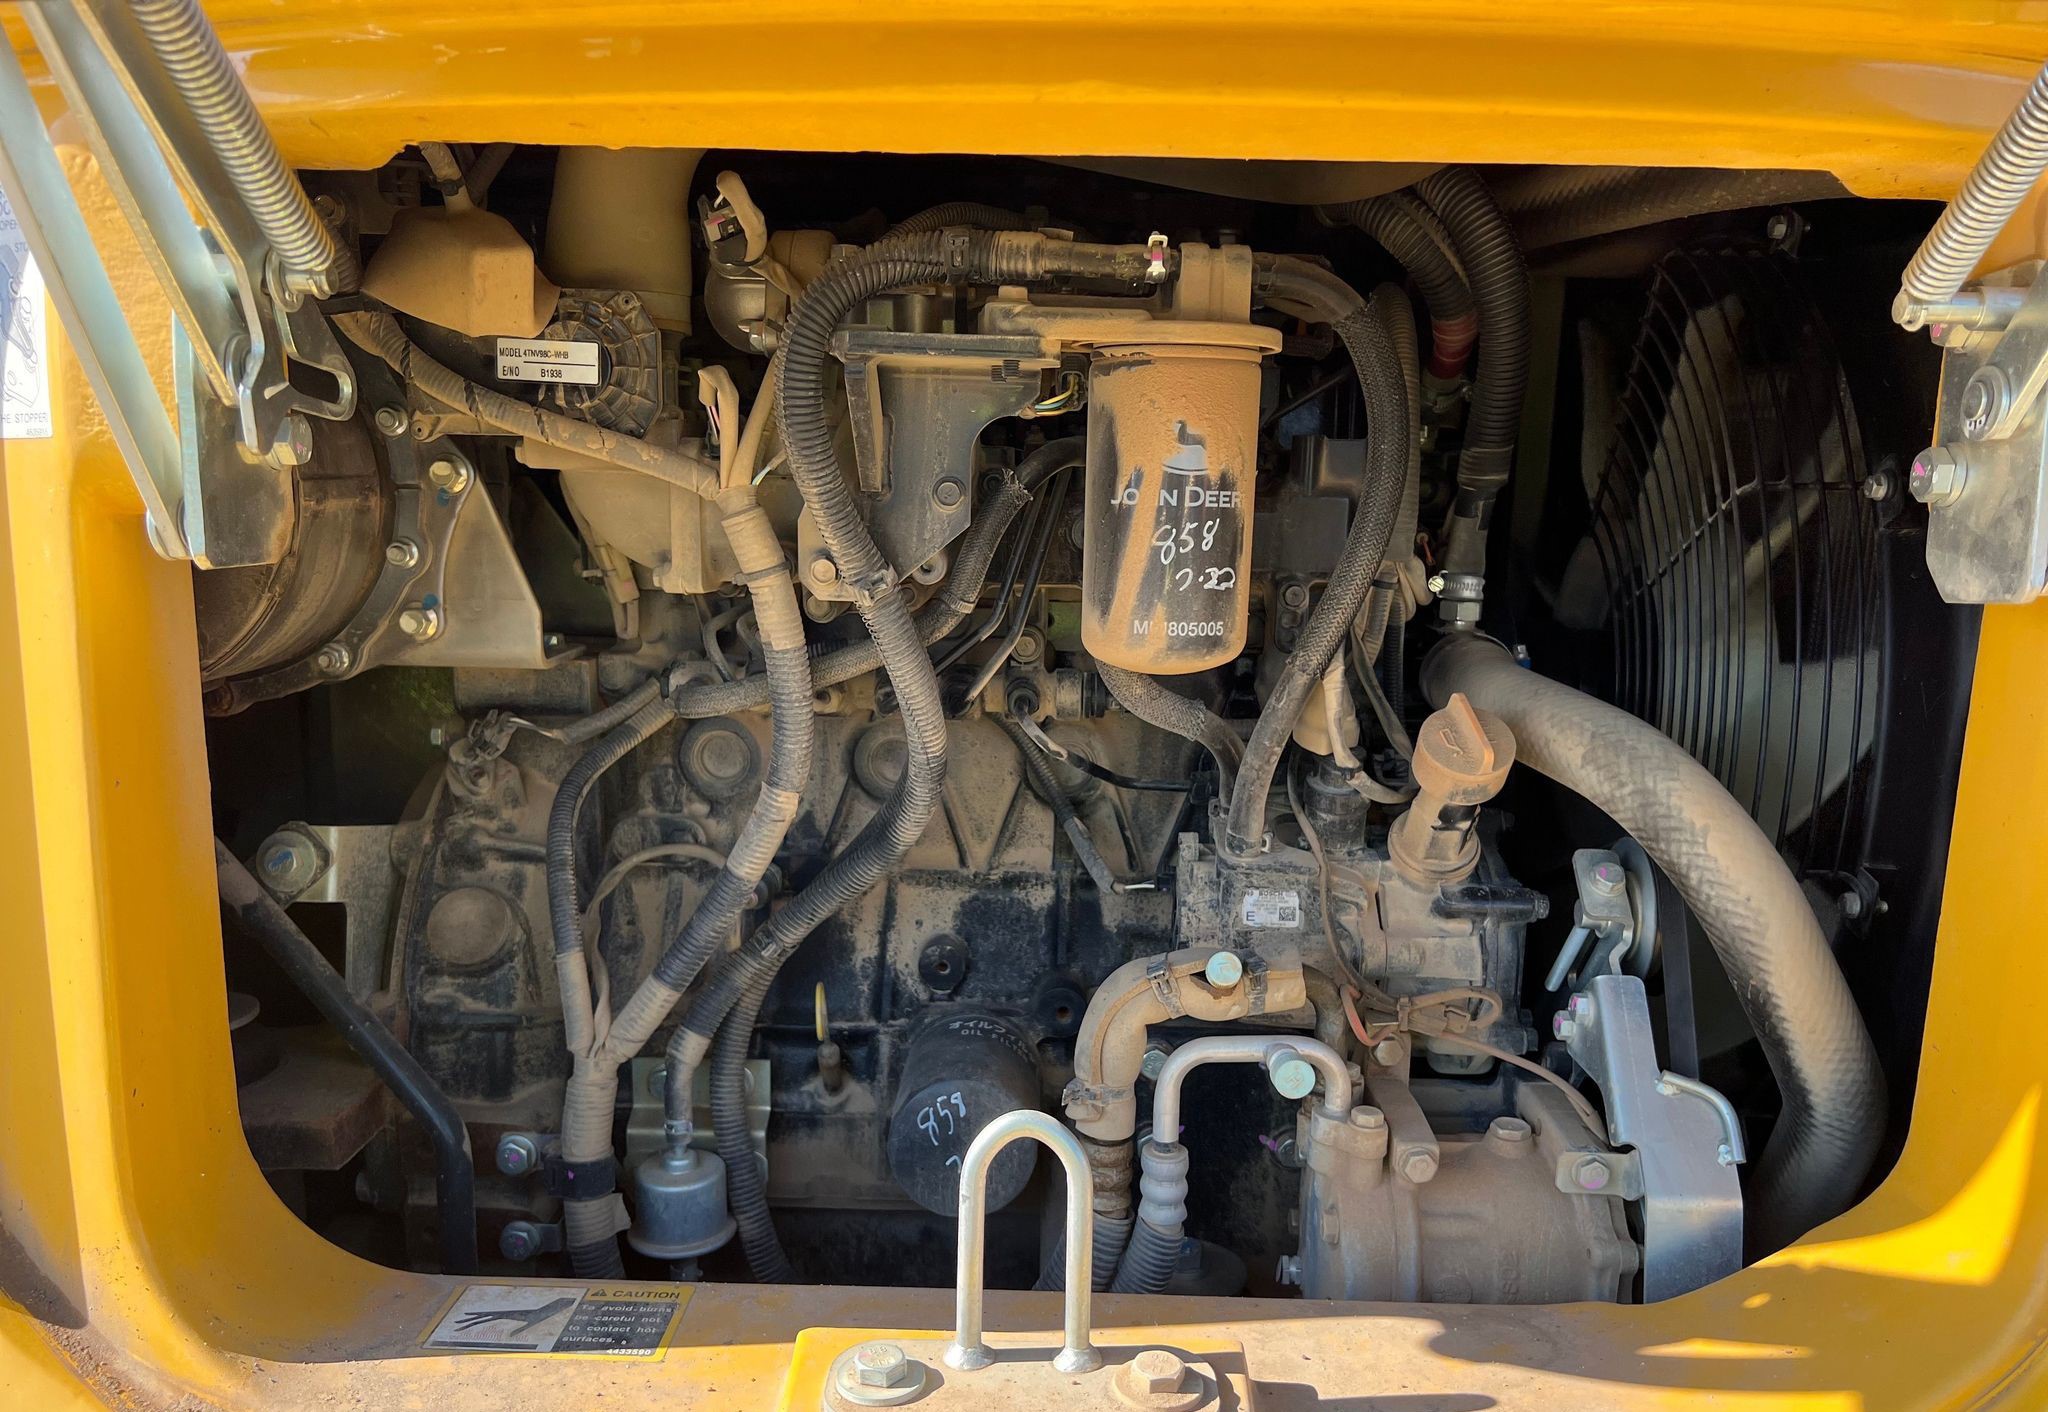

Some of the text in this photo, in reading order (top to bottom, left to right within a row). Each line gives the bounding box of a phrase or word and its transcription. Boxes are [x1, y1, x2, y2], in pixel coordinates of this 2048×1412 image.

[499, 347, 569, 359] MODEL 4TNV98C-WHB
[502, 365, 563, 379] E/NO B1938
[1110, 487, 1178, 508] JON
[1151, 517, 1221, 566] 858
[1133, 619, 1224, 637] M805005
[1246, 910, 1256, 922] E
[612, 1289, 681, 1299] CAUTION
[601, 1304, 634, 1312] avoid
[594, 1314, 636, 1323] careful
[568, 1324, 657, 1333] to contact hot
